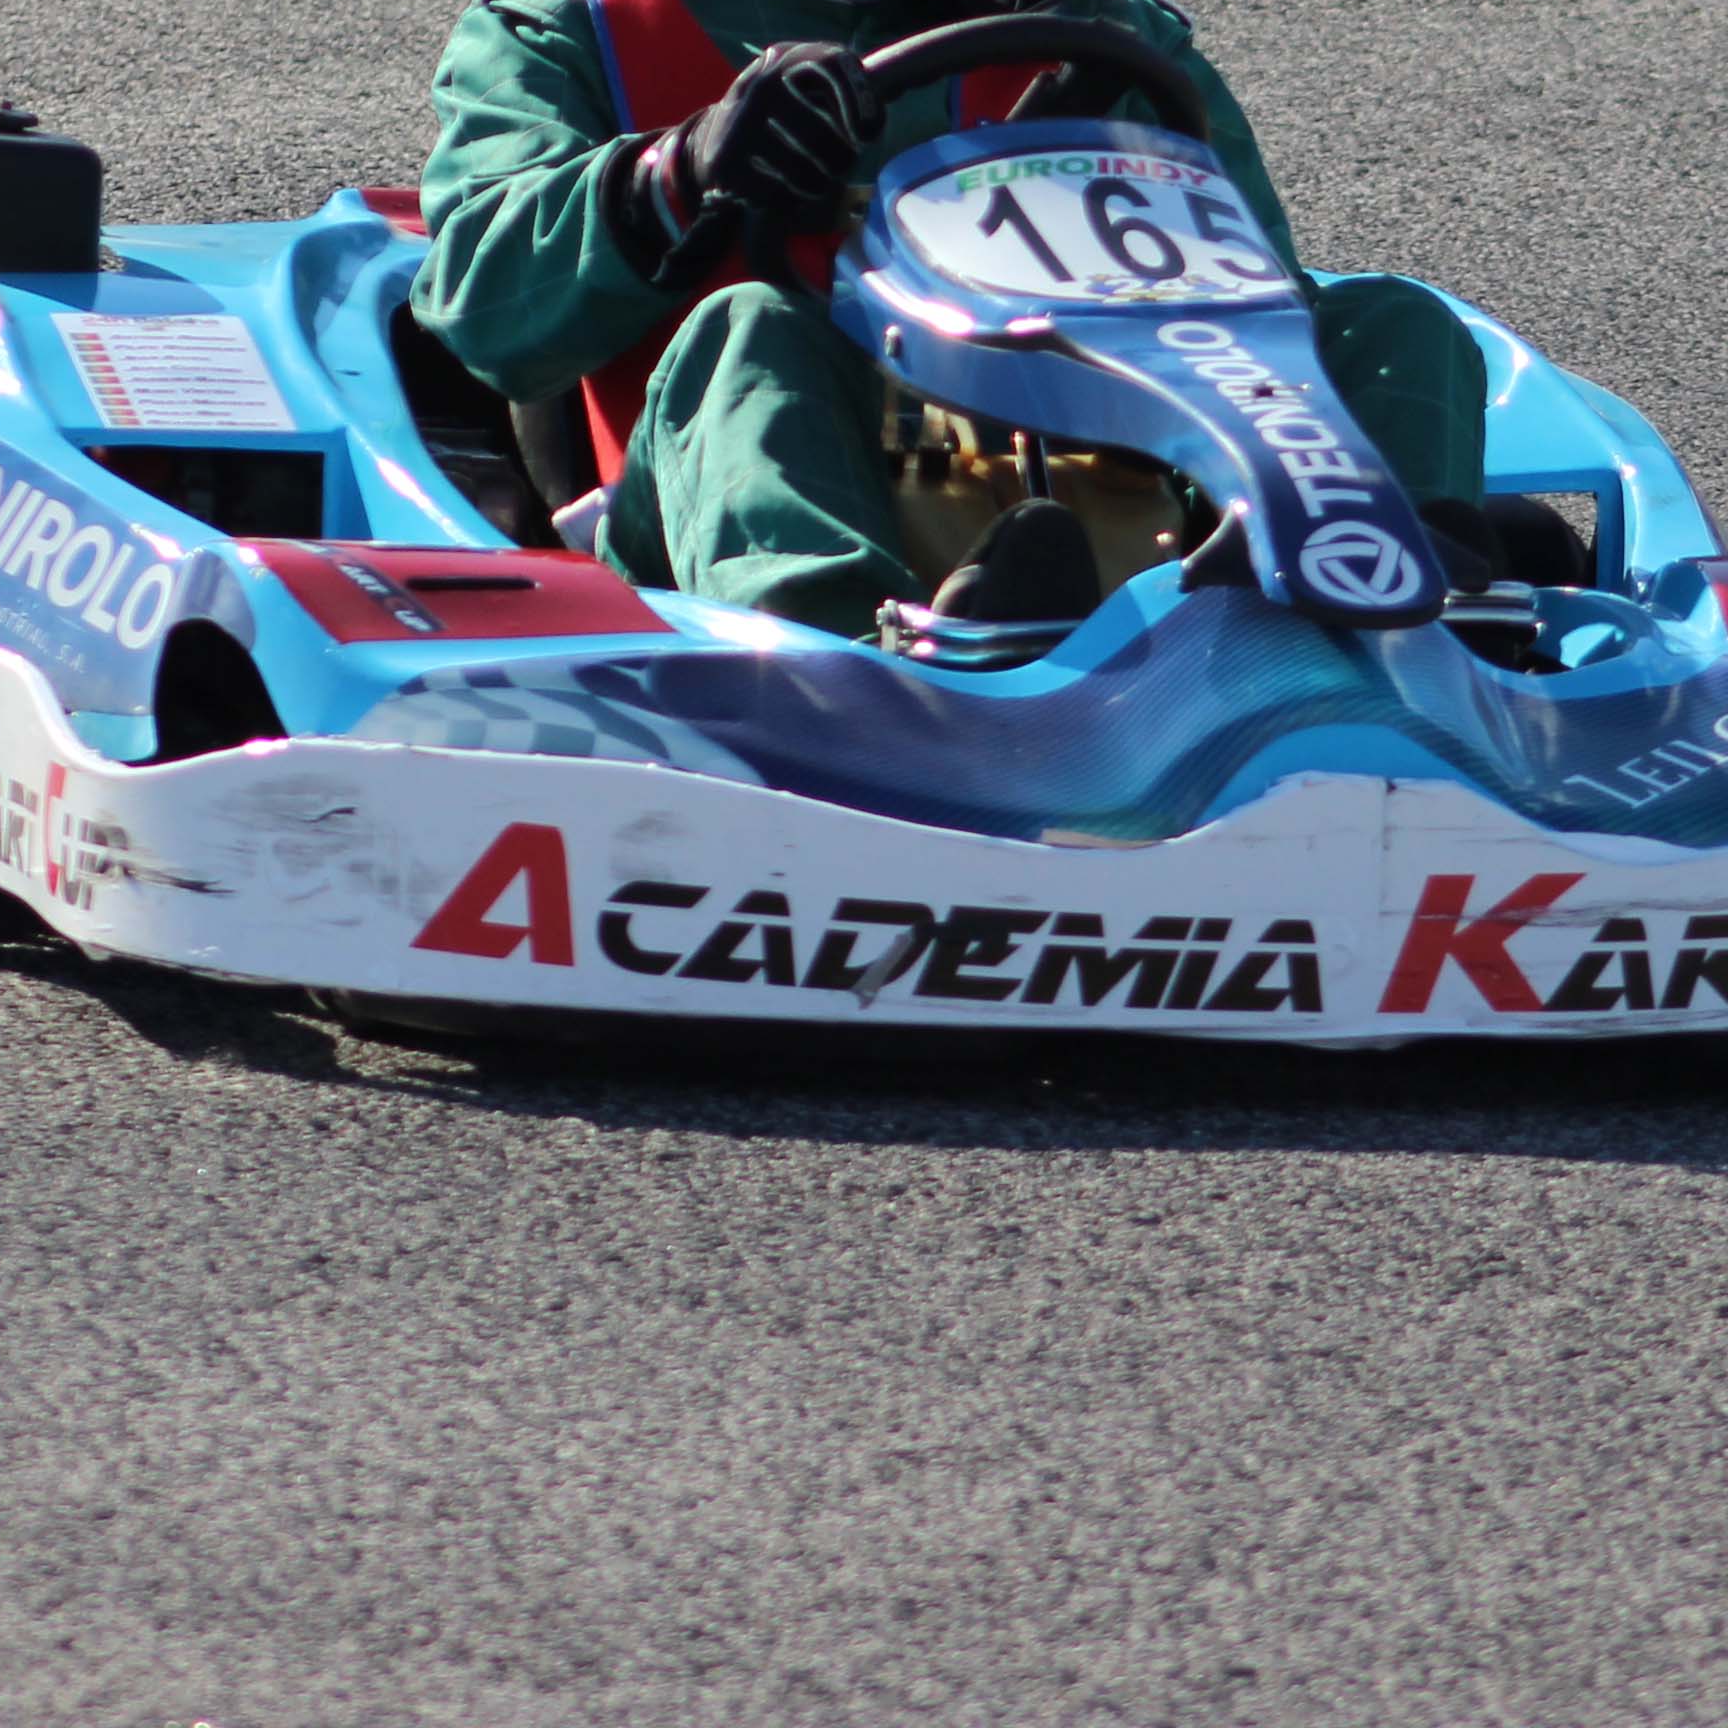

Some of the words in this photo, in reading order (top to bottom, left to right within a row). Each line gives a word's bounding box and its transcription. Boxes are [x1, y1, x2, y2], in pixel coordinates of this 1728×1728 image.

[955, 156, 1210, 191] EUROINDY
[977, 175, 1291, 283] 165
[1156, 320, 1373, 519] TECNIROLO
